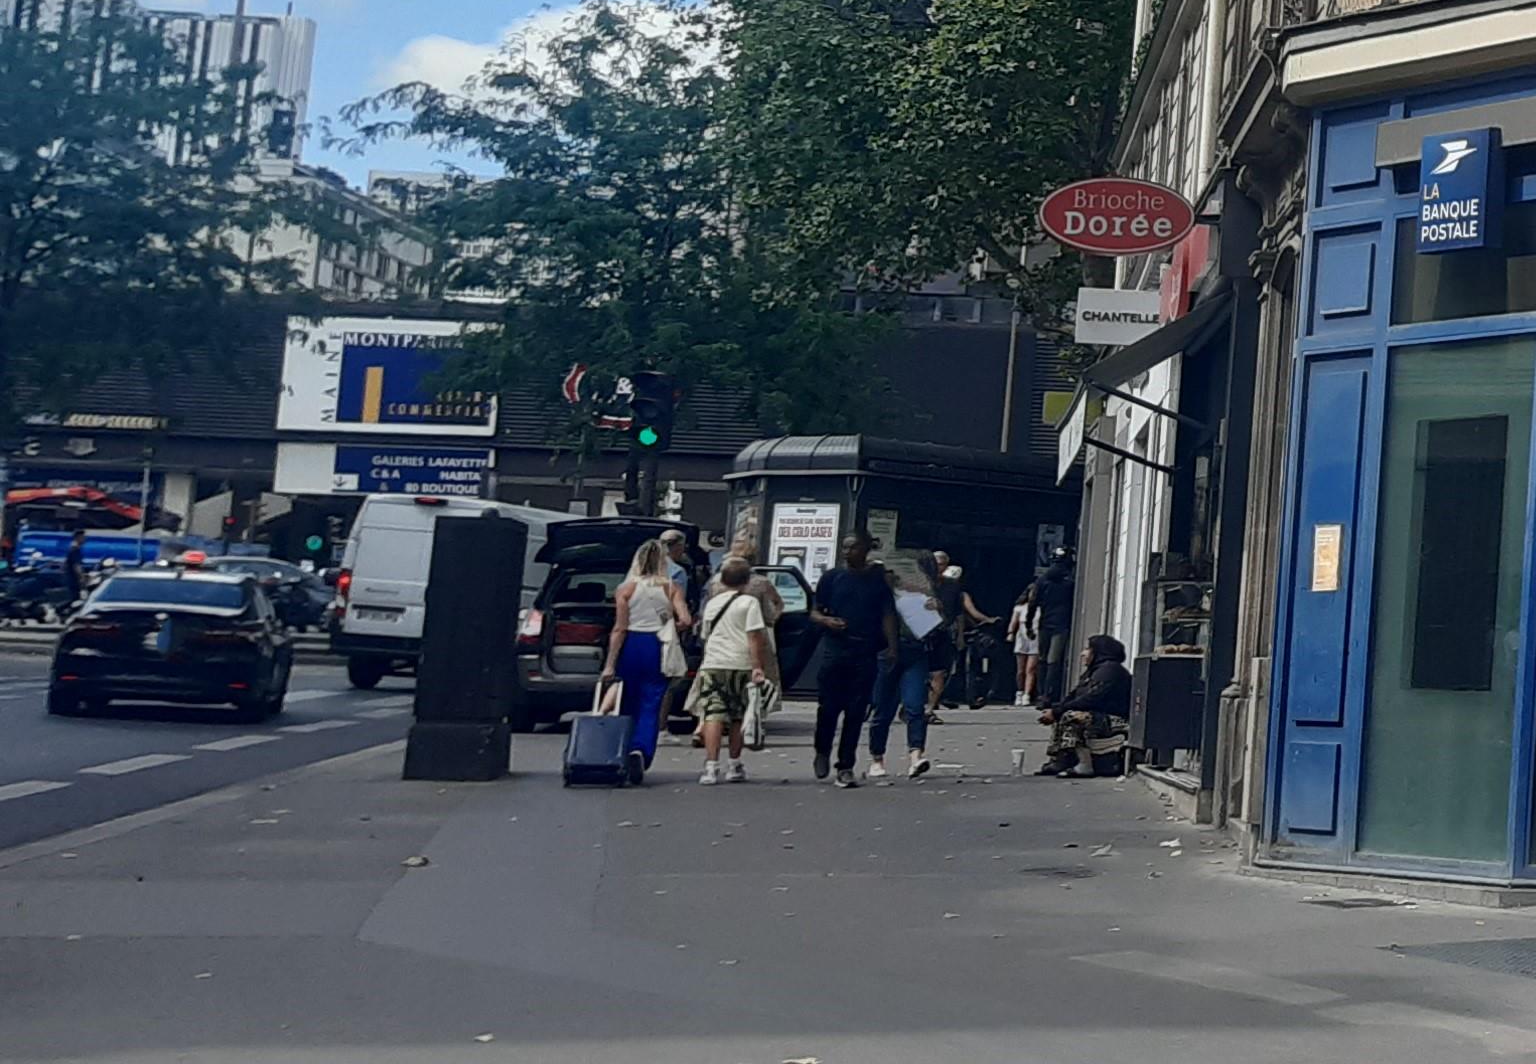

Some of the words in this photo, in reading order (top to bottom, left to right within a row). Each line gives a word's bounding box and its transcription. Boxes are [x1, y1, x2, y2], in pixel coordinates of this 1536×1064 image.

[1073, 189, 1165, 210] Brioche
[1424, 182, 1440, 201] LA
[1422, 199, 1479, 222] BANQUE
[1064, 211, 1172, 237] Dorée
[1421, 220, 1478, 243] POSTALE
[1082, 311, 1160, 324] CHANTELLE
[372, 456, 424, 467] GALERIES
[440, 471, 481, 481] HABITA
[422, 483, 478, 493] BOUTIQUE
